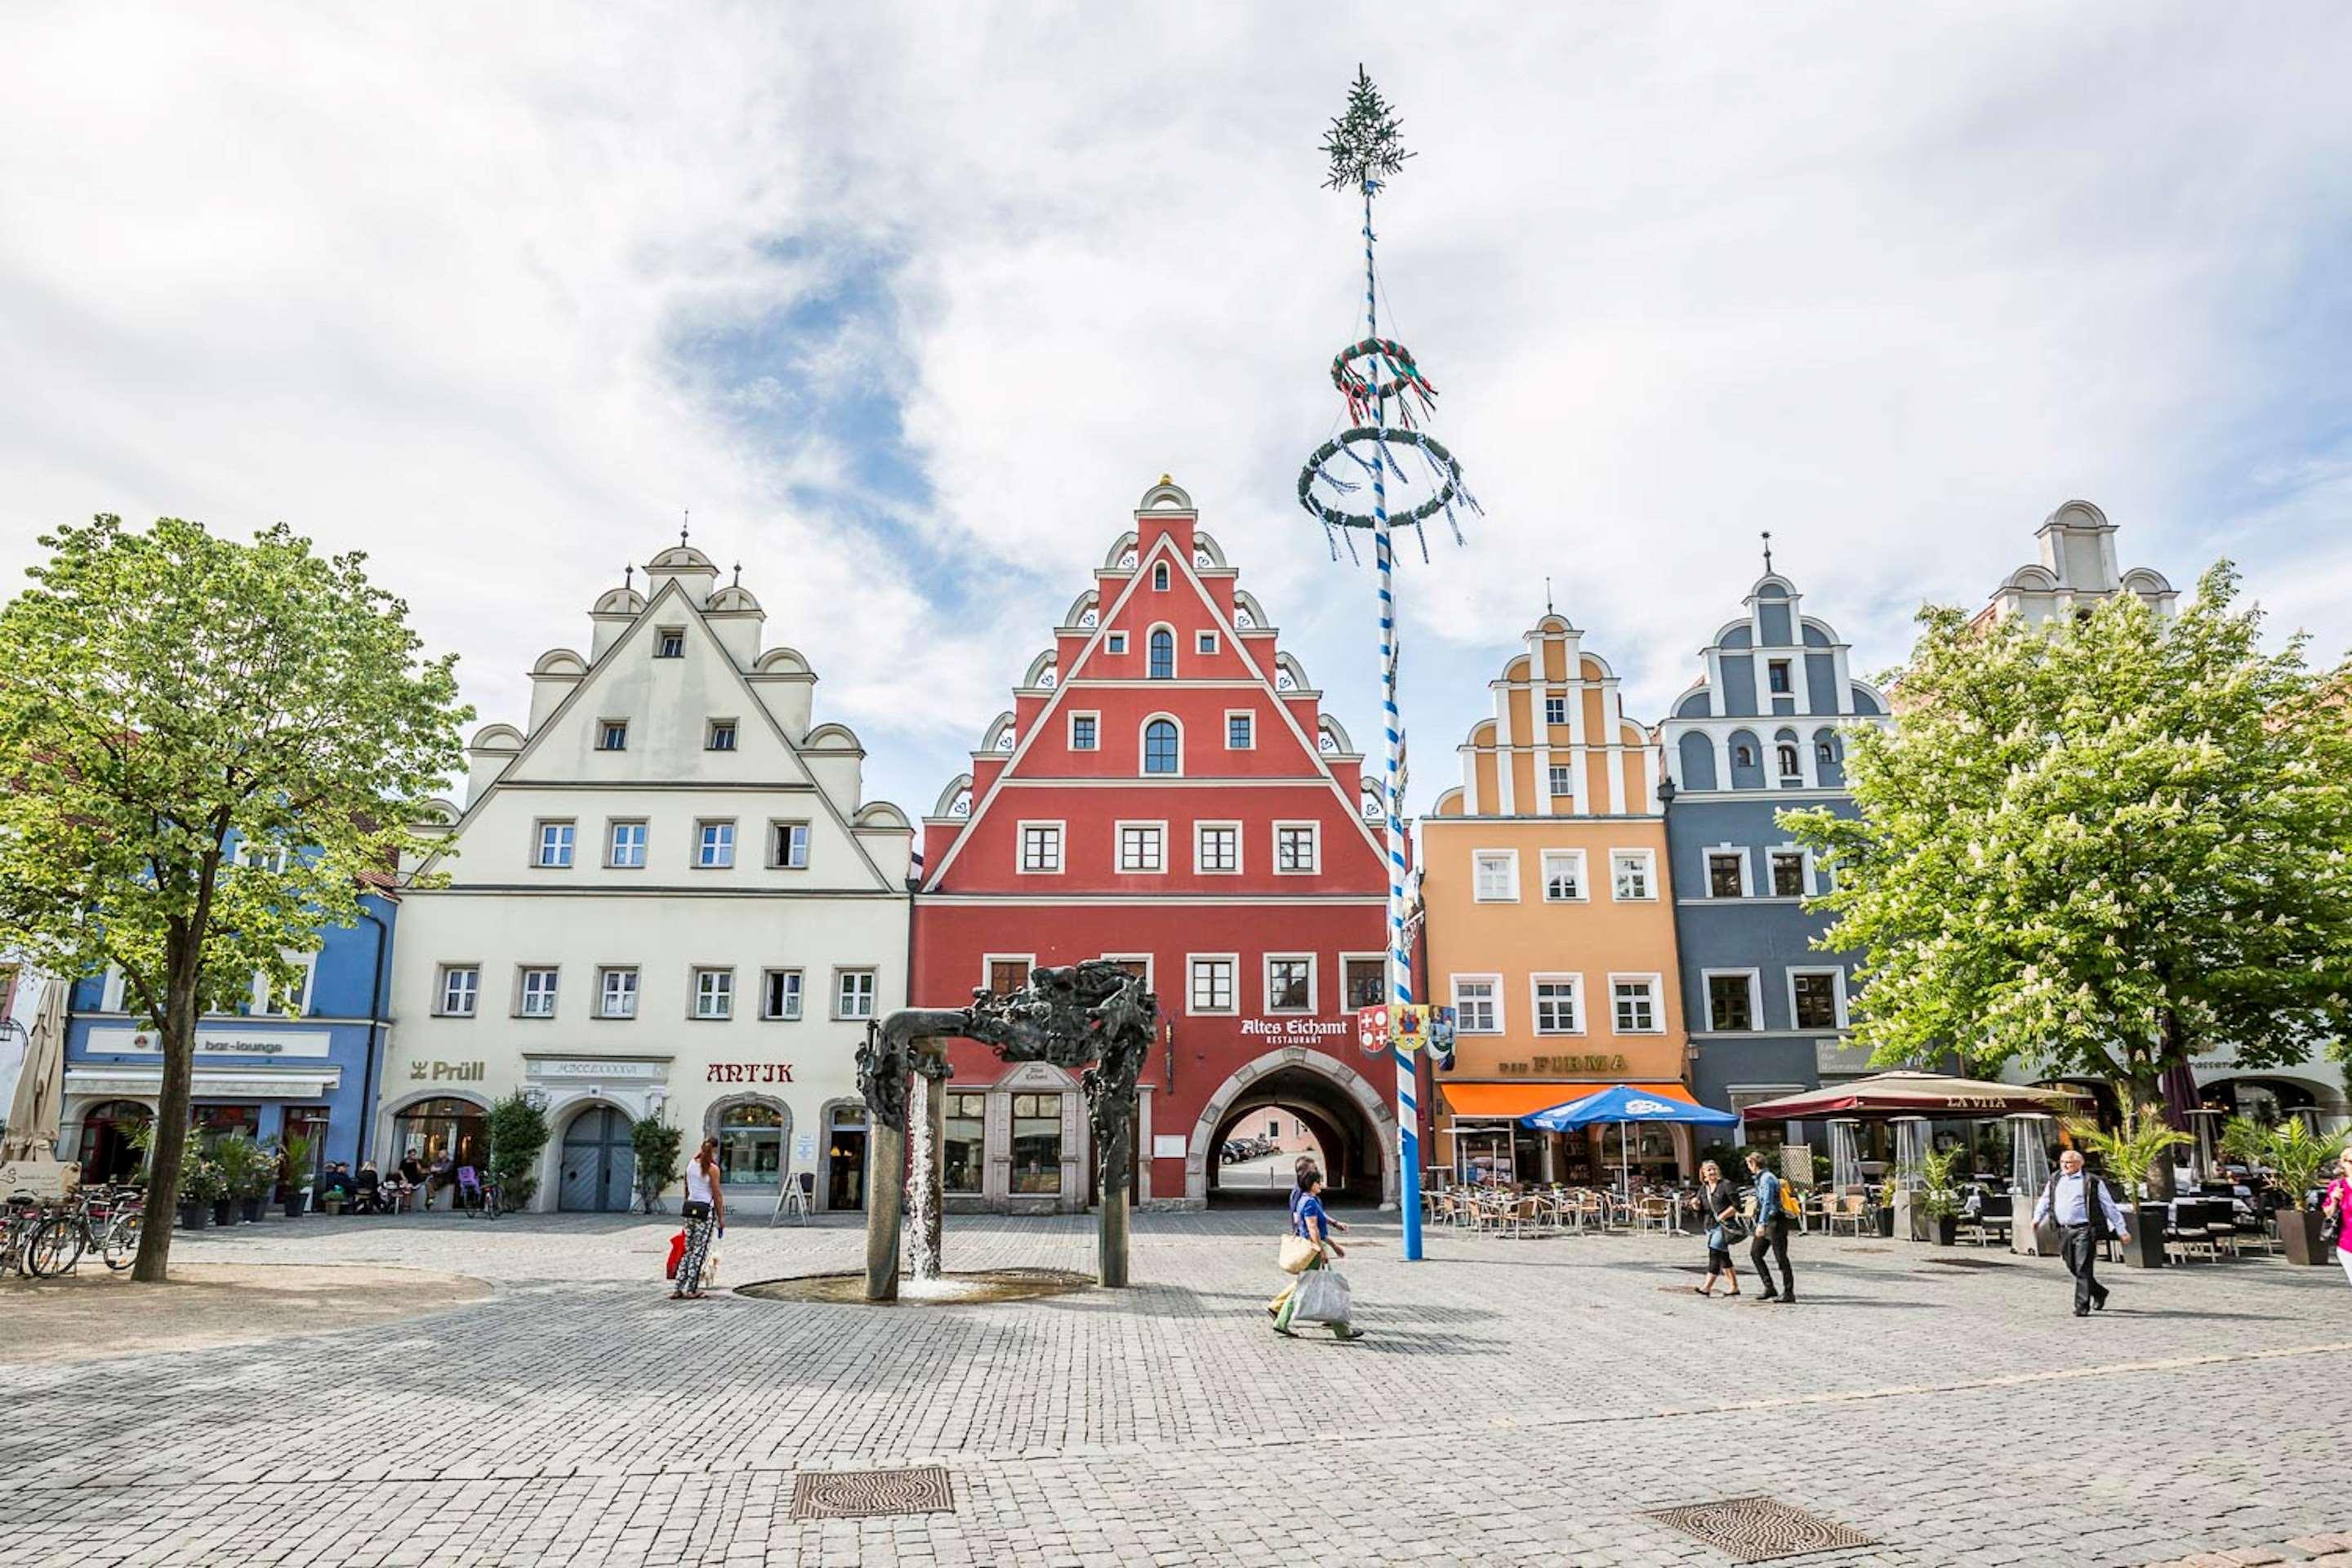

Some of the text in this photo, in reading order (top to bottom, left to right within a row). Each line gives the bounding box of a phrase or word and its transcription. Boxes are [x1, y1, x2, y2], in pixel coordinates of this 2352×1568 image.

[1241, 1018, 1348, 1036] Altes Eichamt
[205, 1040, 283, 1054] bar-lounge
[1266, 1036, 1322, 1044] RESTAURANT
[432, 1061, 484, 1081] Prüll
[1532, 1054, 1628, 1072] FIRMA
[1946, 1097, 2007, 1108] LA VITA
